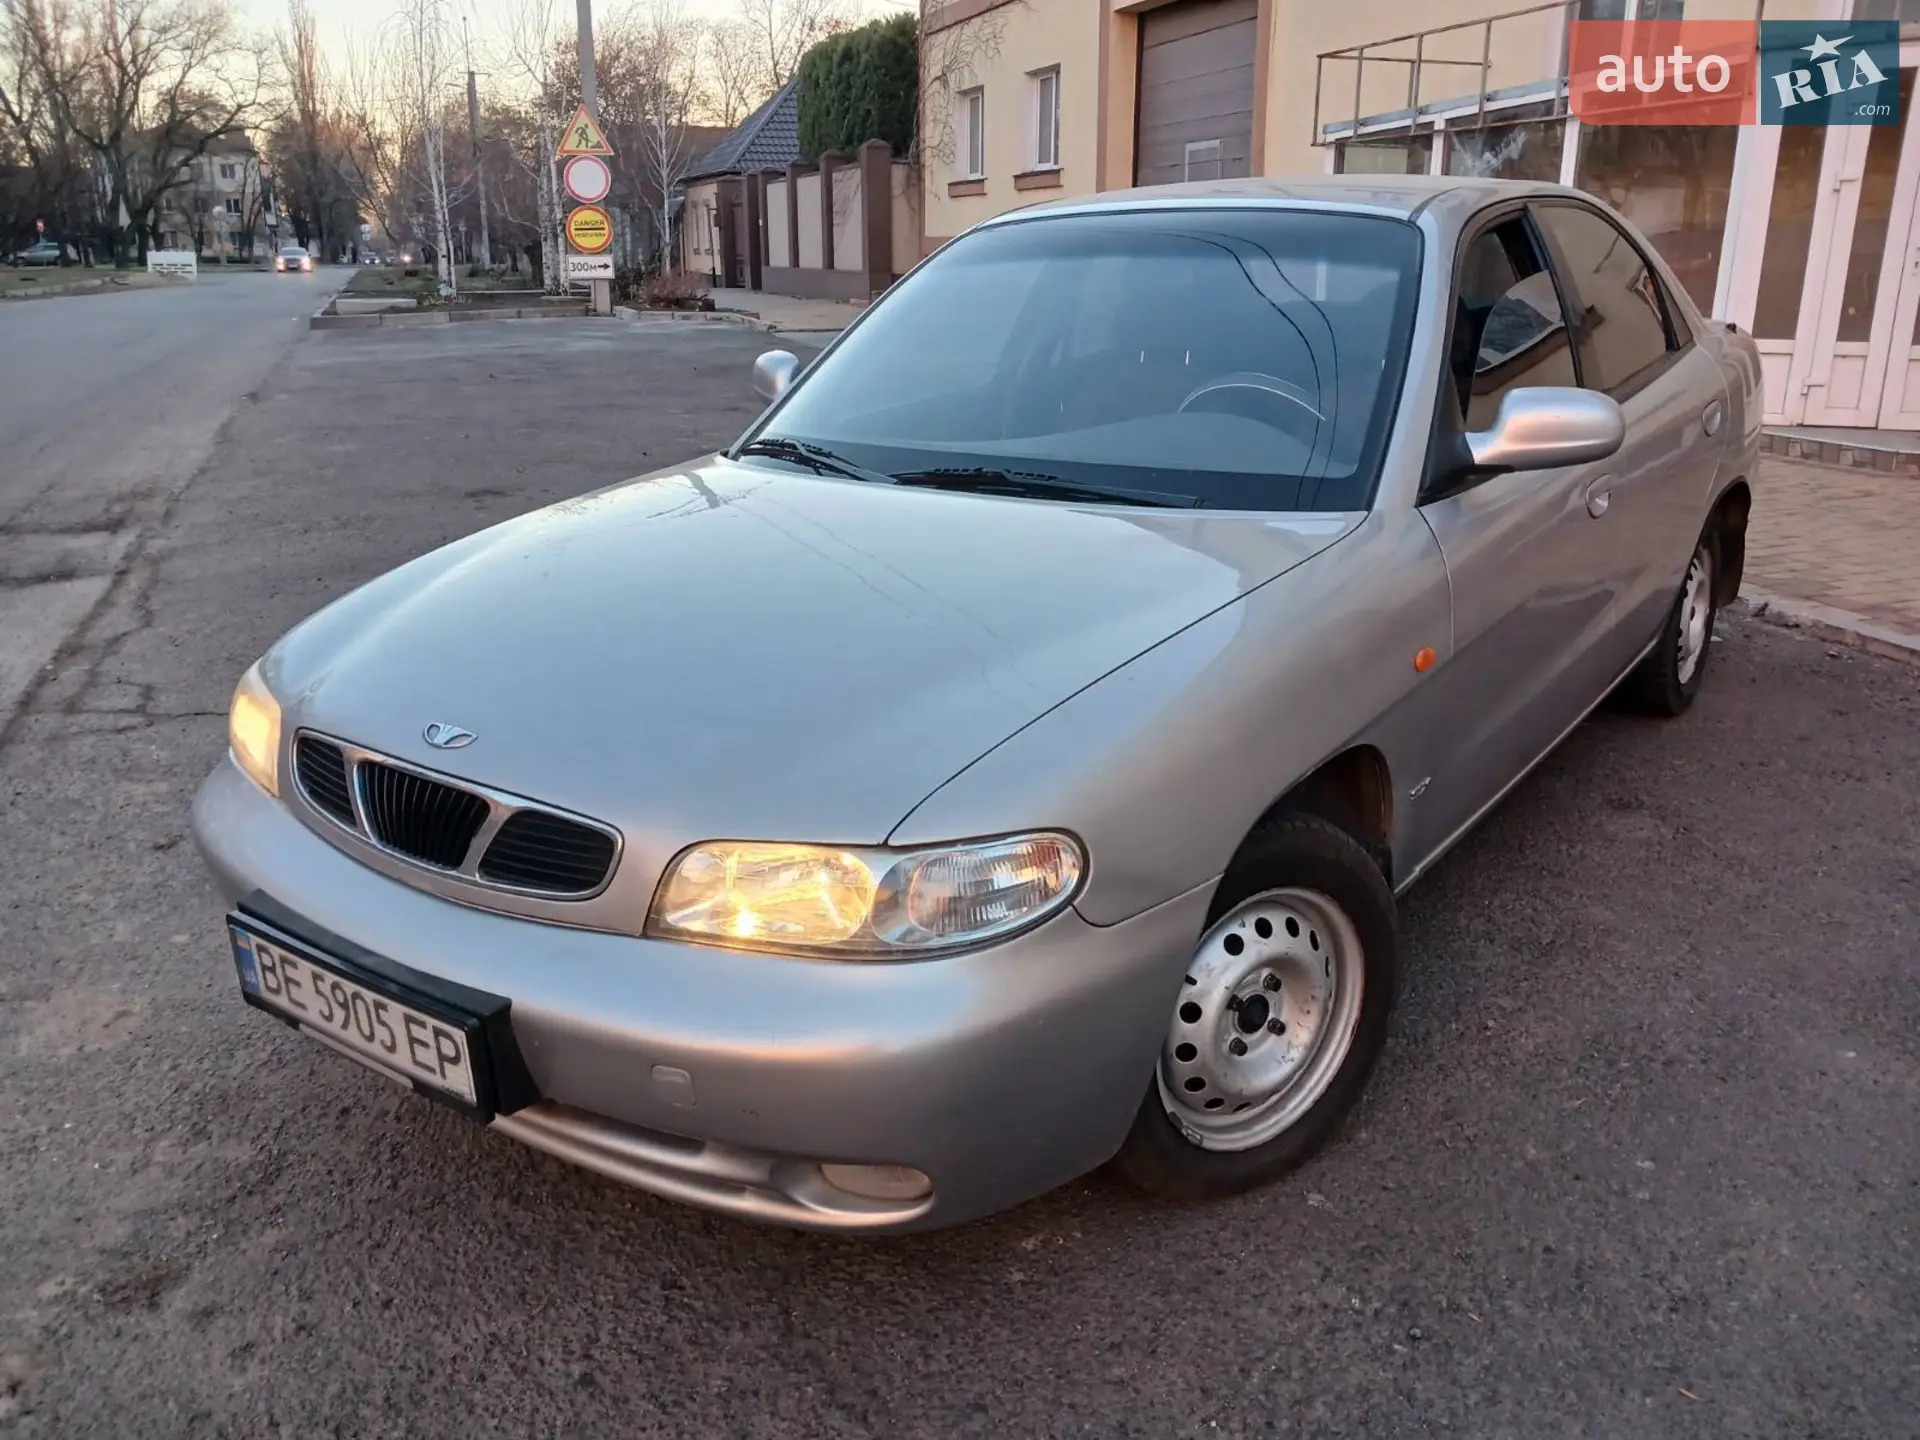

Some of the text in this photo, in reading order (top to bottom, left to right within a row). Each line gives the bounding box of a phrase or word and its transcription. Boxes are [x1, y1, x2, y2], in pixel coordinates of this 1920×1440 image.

[255, 943, 462, 1080] BE 5905 EP
